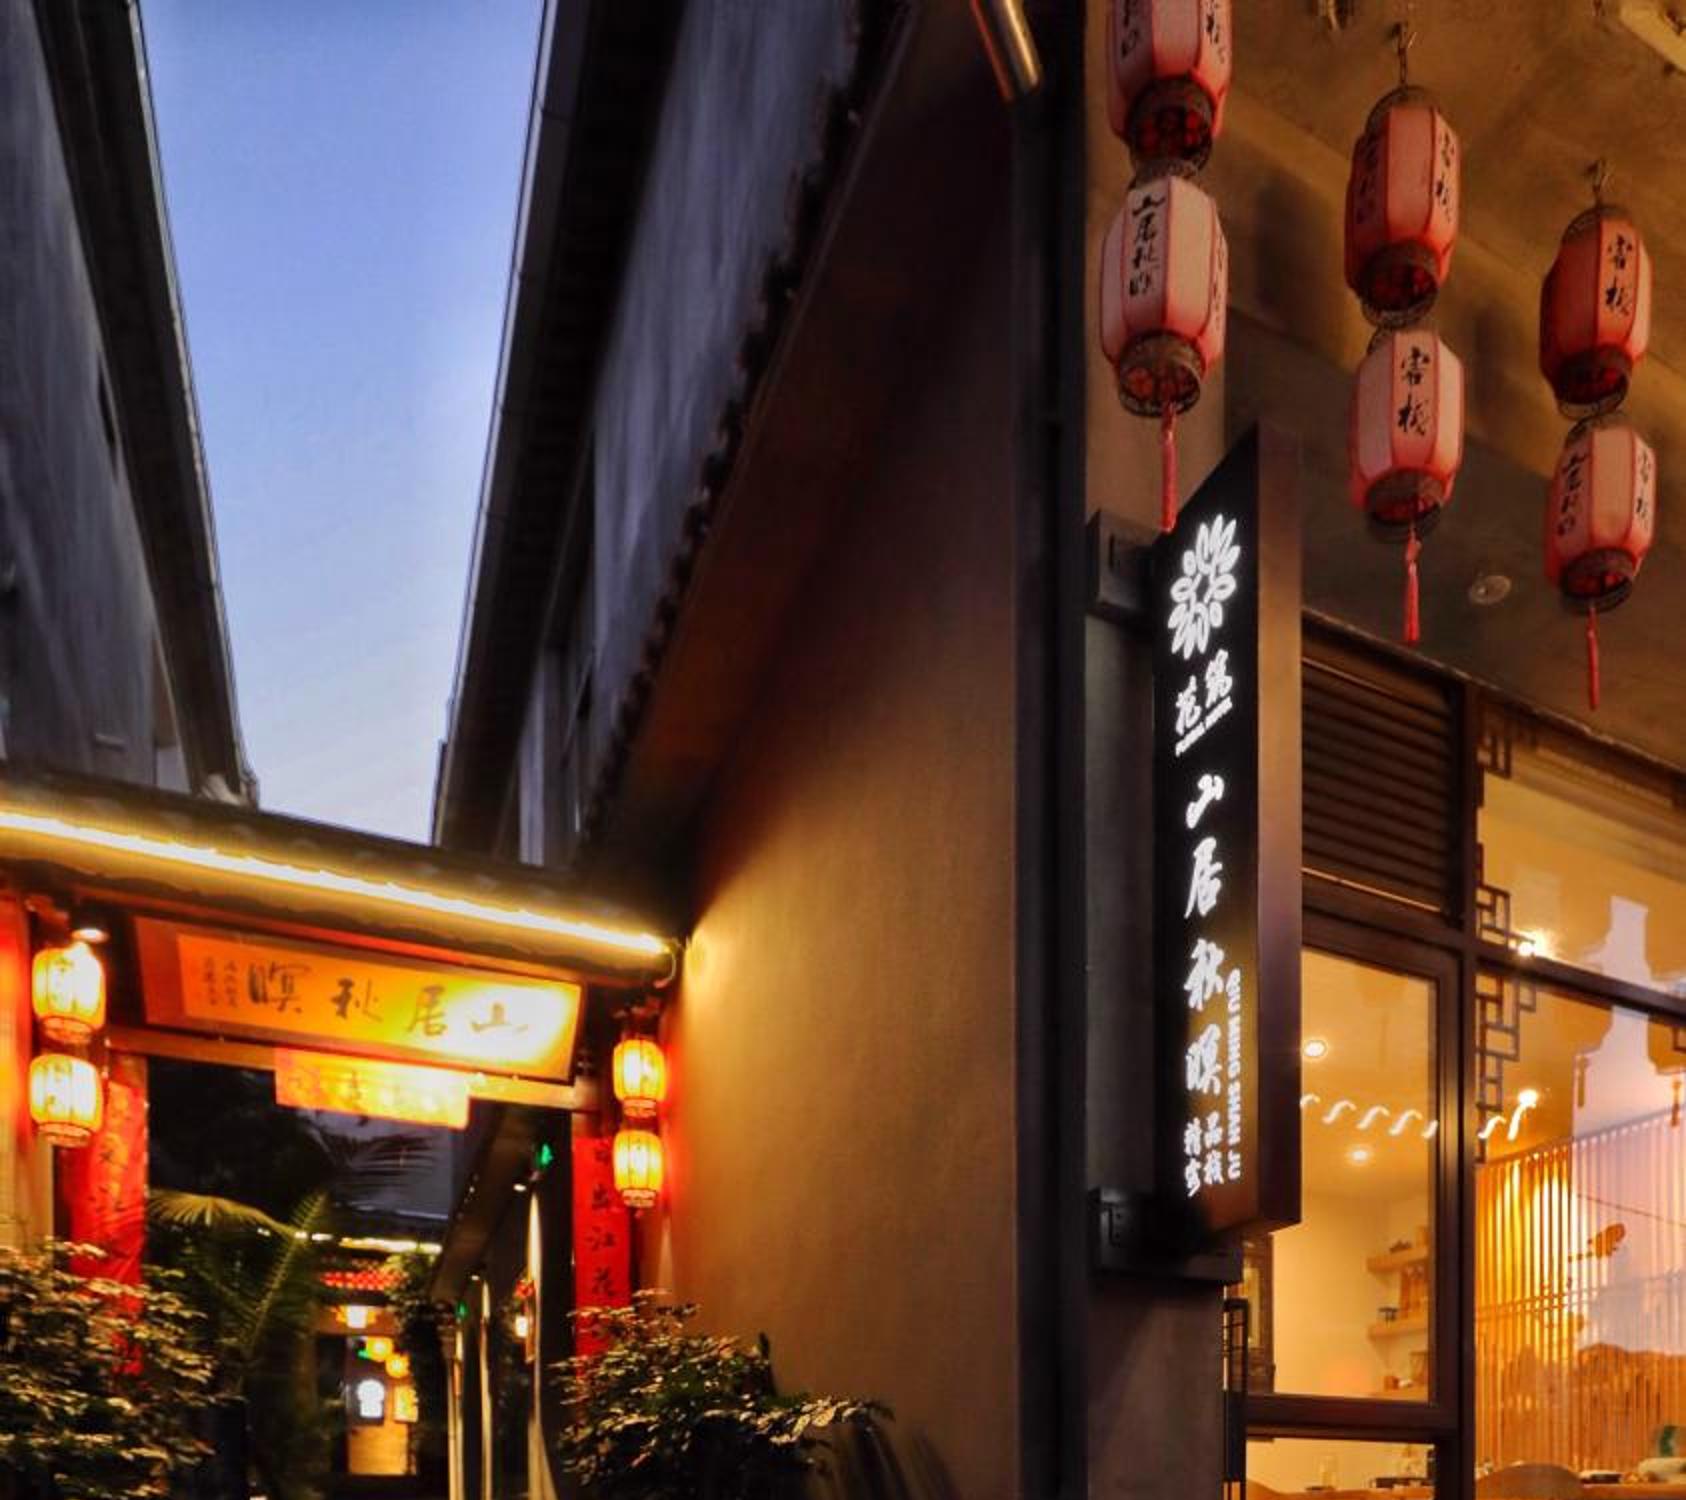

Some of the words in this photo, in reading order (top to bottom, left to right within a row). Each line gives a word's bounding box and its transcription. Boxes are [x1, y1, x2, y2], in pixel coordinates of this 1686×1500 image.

[247, 961, 529, 1037] 山居秋暝
[1184, 773, 1225, 1096] 山居秋暝
